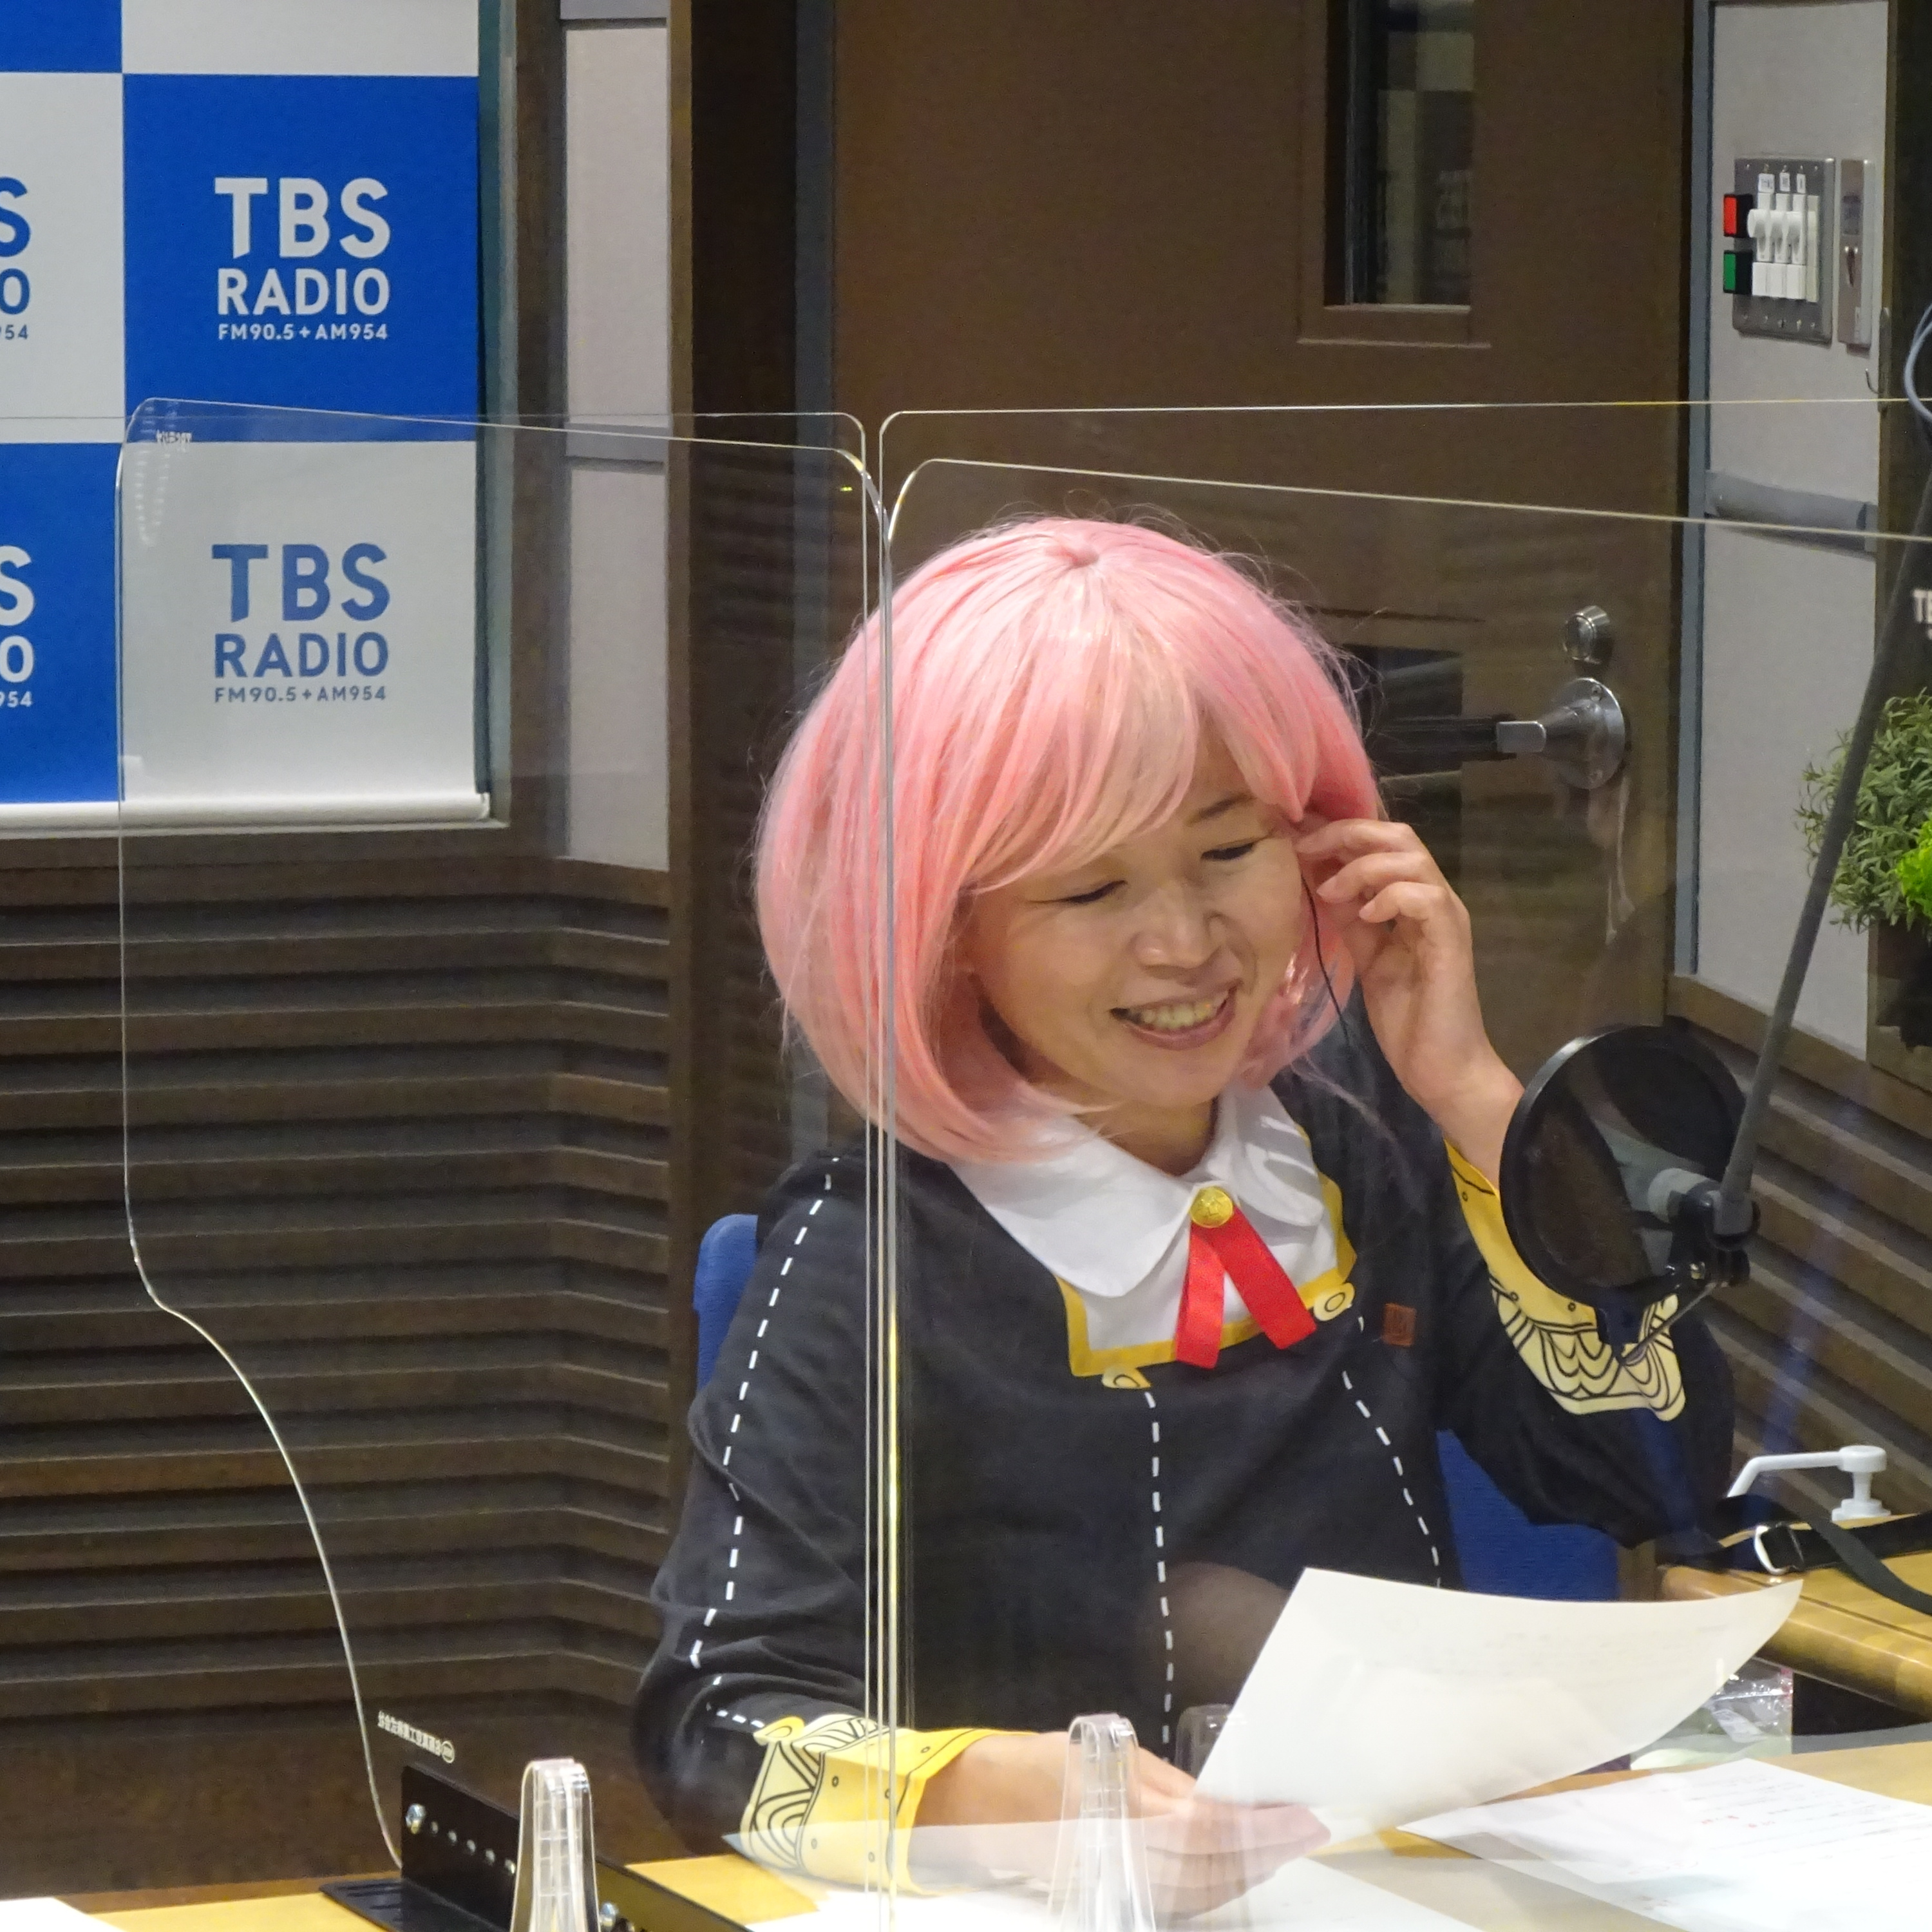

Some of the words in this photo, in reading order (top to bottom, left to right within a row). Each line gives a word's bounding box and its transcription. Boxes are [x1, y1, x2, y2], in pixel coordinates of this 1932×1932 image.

[0, 176, 31, 258] S
[214, 177, 390, 259] TBS
[0, 268, 30, 315] O
[218, 268, 390, 316] RADIO
[0, 324, 28, 340] 54
[0, 545, 34, 626] S
[211, 543, 390, 622] TBS
[0, 635, 34, 683] O
[214, 632, 388, 677] RADIO
